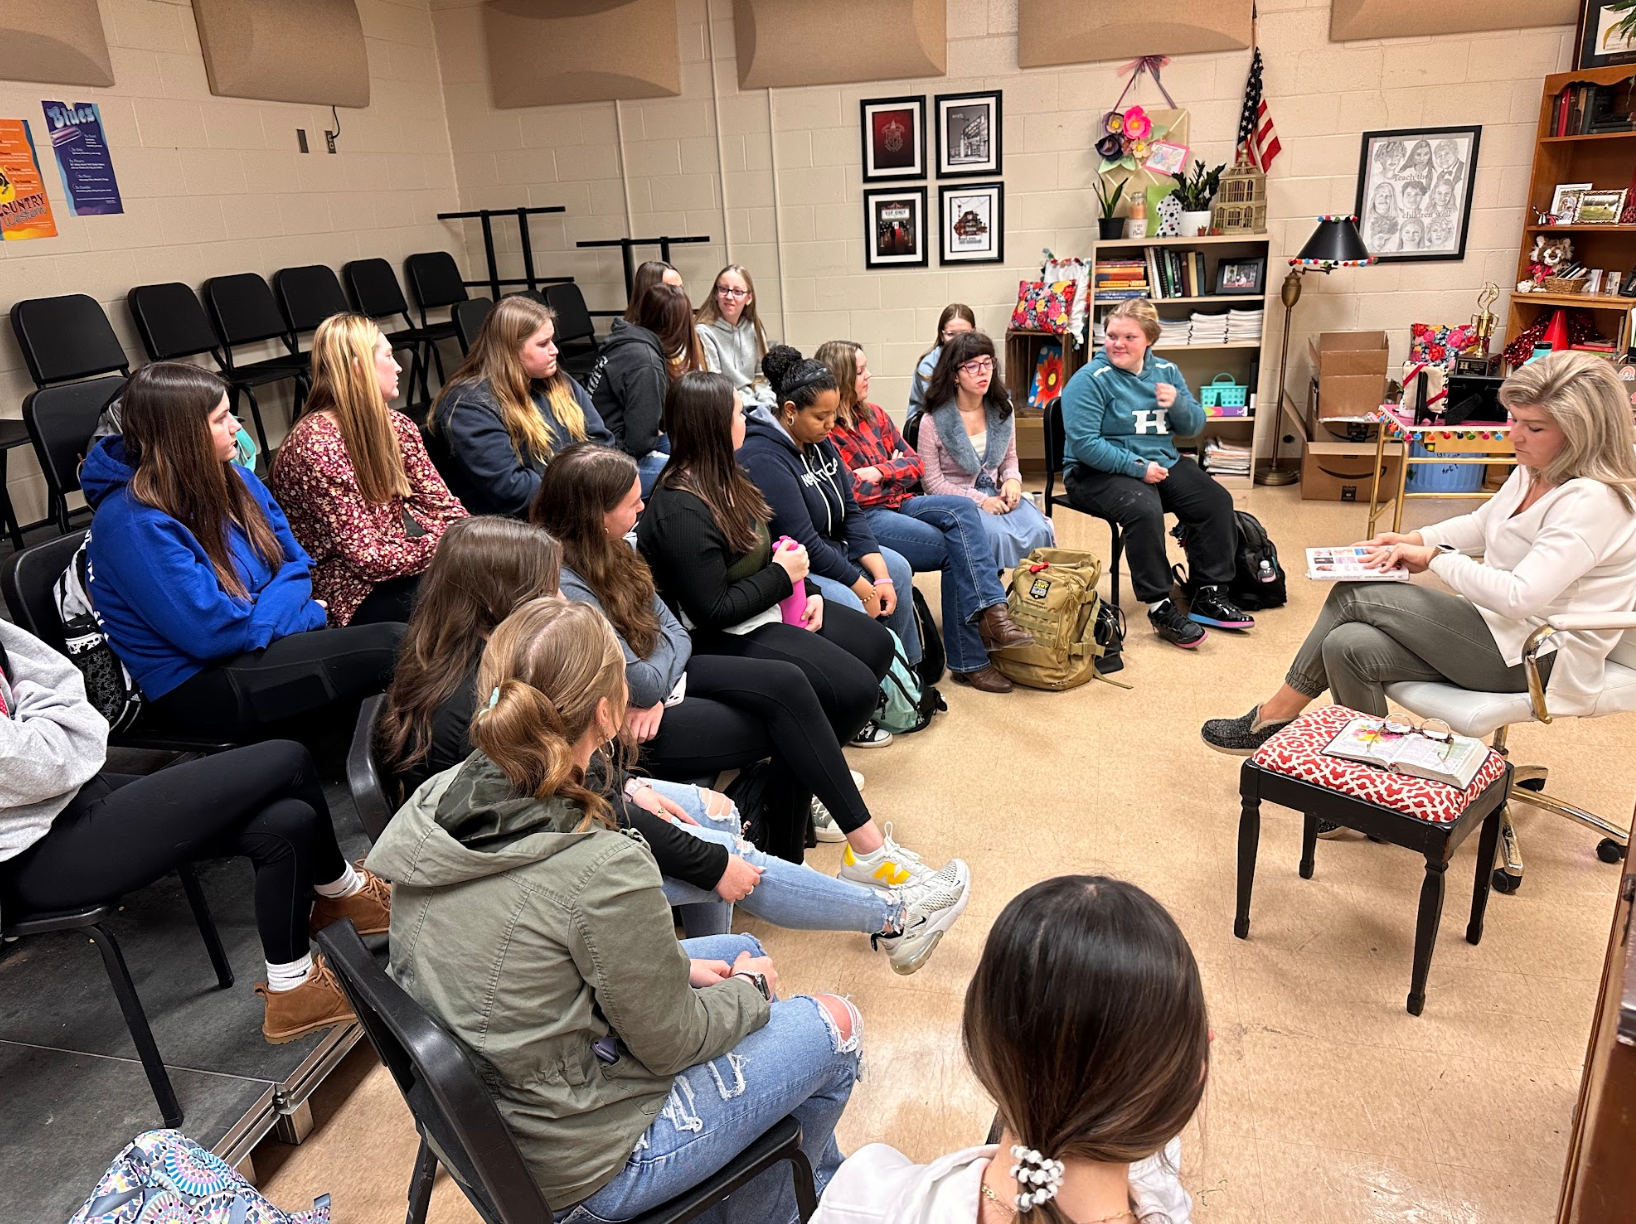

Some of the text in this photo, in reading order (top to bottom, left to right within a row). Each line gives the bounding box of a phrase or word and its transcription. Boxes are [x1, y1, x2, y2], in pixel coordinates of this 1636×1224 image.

[46, 105, 96, 128] Blues
[1393, 173, 1414, 181] Teach
[1459, 361, 1470, 370] H
[1131, 408, 1169, 434] H
